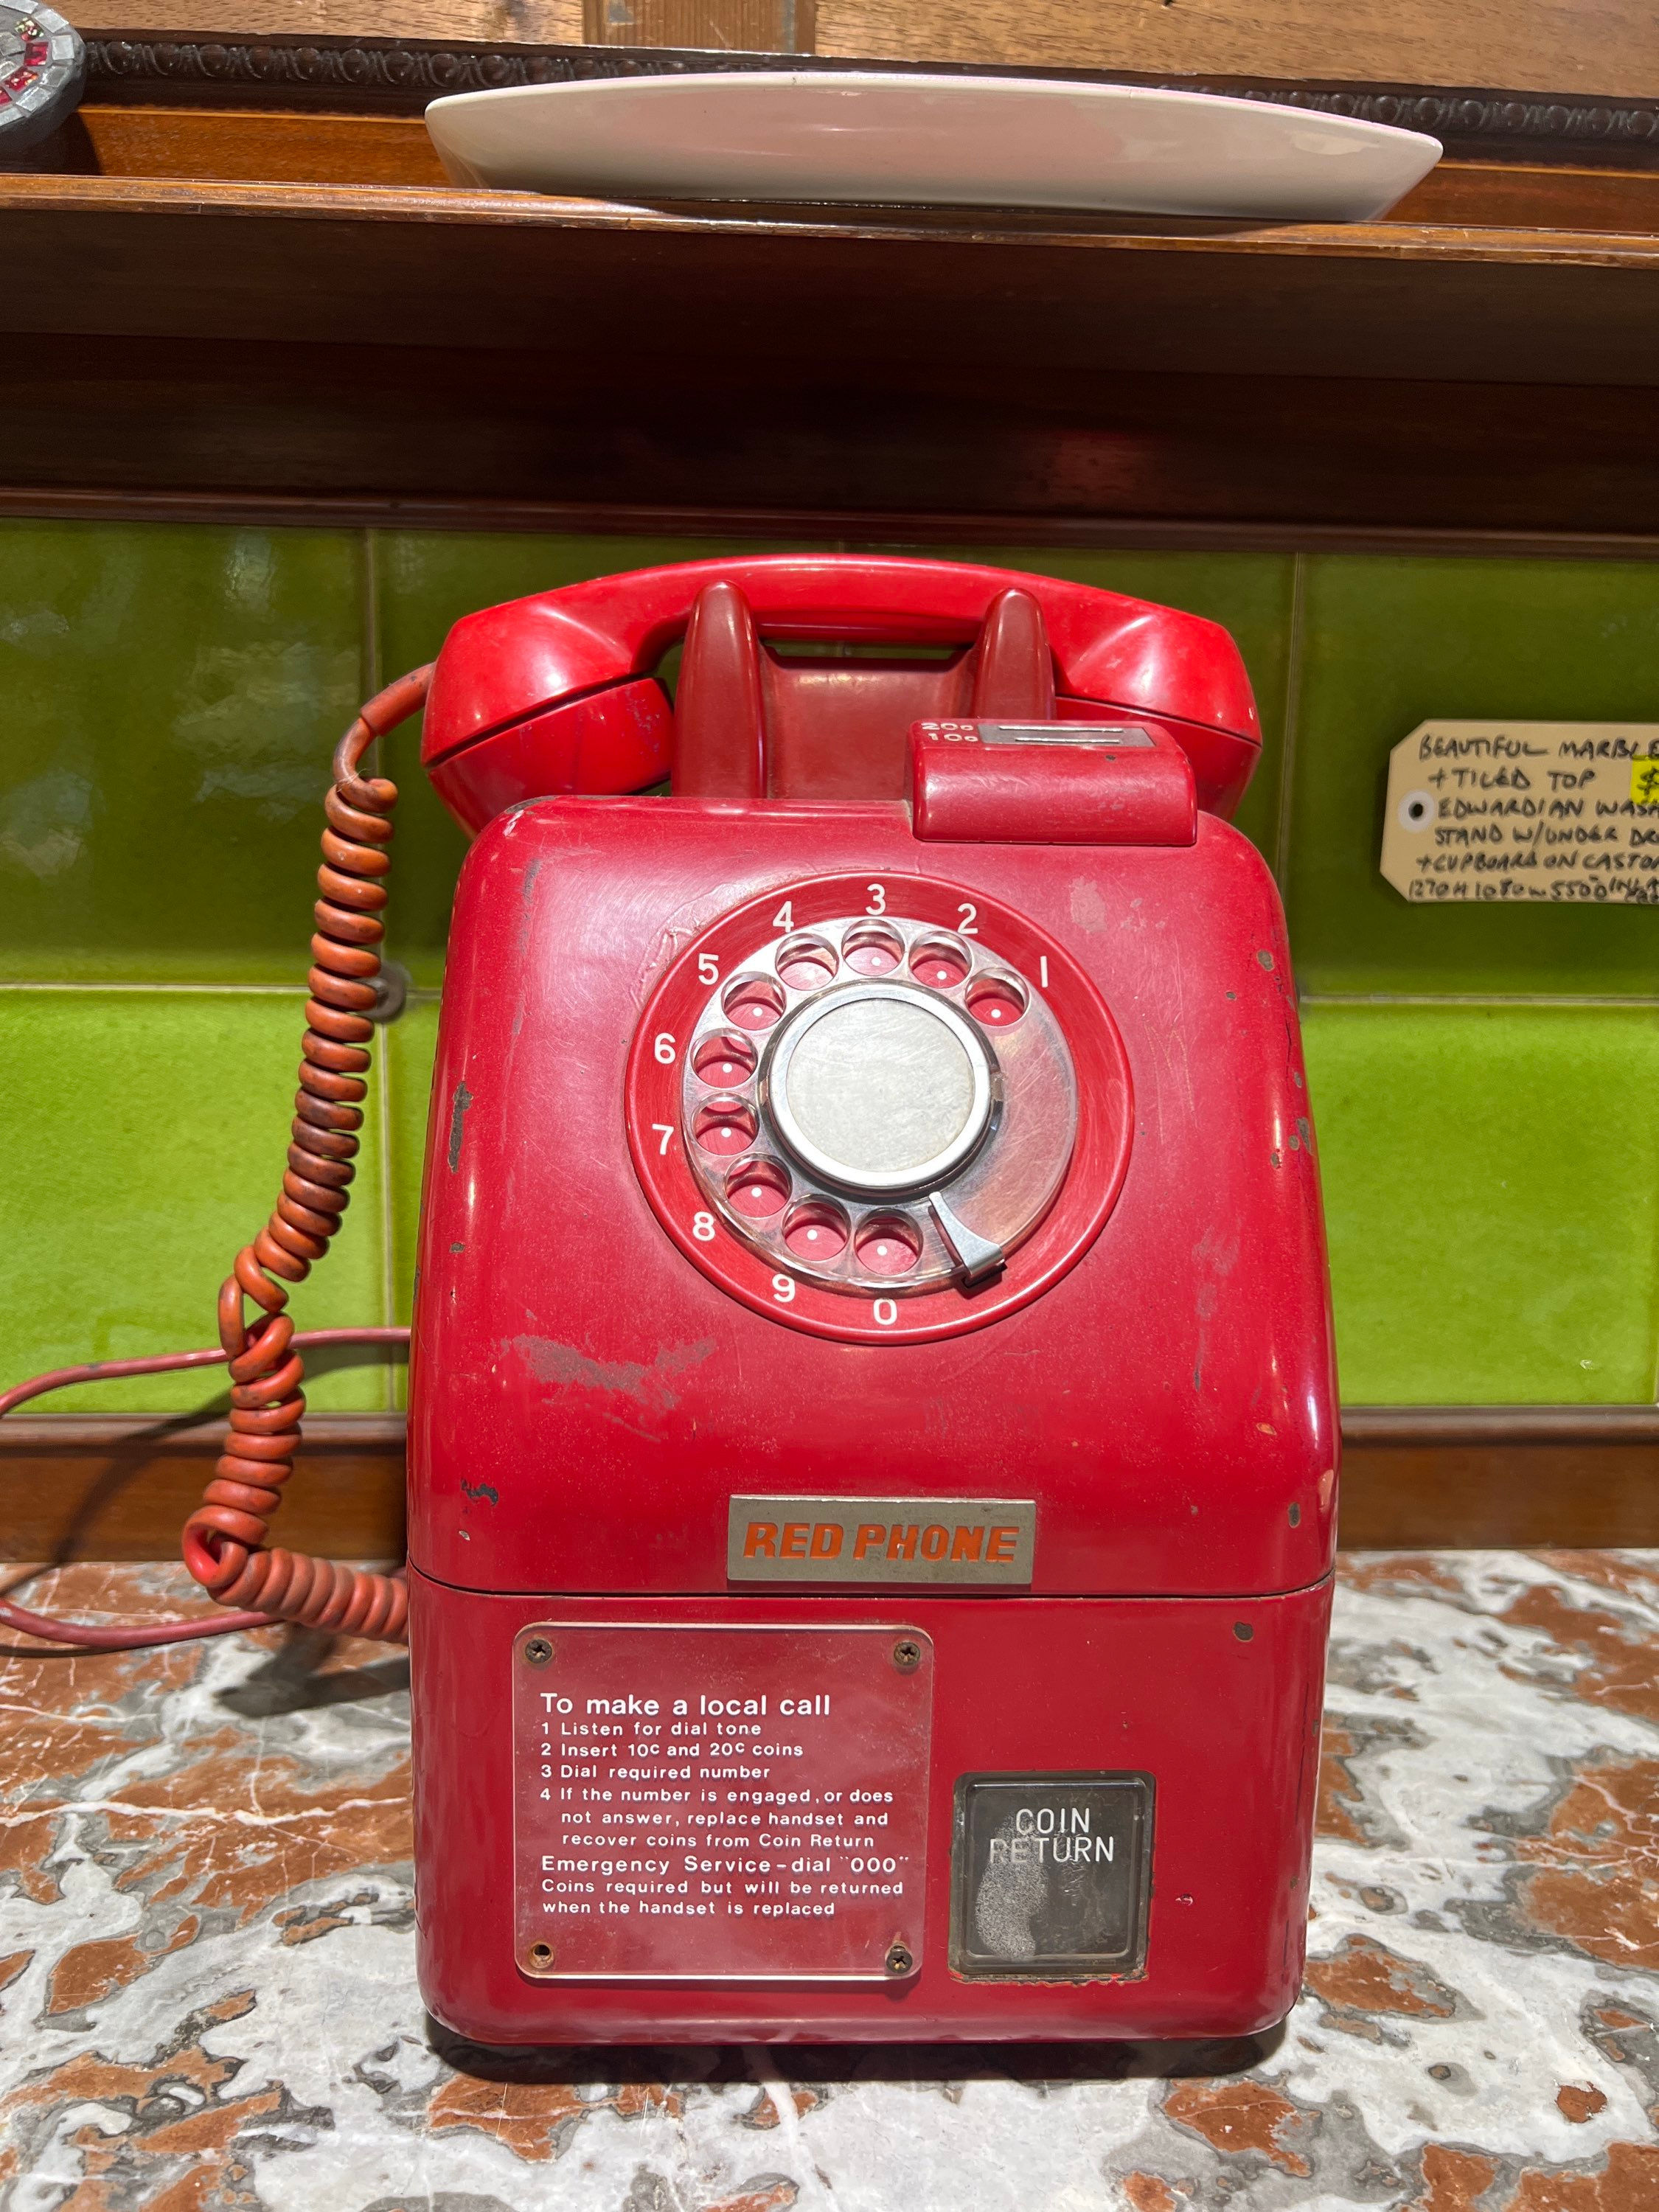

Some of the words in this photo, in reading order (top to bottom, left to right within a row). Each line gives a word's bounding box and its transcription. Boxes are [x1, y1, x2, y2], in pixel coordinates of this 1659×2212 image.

[1419, 734, 1548, 761] BEAUTIFUL
[1547, 768, 1595, 792] TOP
[1438, 796, 1583, 820] EDWARDIAN
[1434, 823, 1503, 846] STAND
[1543, 849, 1578, 869] ON
[866, 883, 886, 916] 3
[772, 900, 797, 934] 4
[953, 902, 978, 938] 2
[698, 953, 722, 987] 5
[1040, 956, 1048, 988] 1
[654, 1032, 676, 1064] 6
[652, 1123, 674, 1155] 7
[692, 1211, 716, 1242] 8
[772, 1273, 796, 1303] 9
[873, 1298, 897, 1326] 0
[742, 1522, 844, 1559] RED
[852, 1523, 1020, 1562] PHONE
[540, 1692, 573, 1714] To
[586, 1694, 660, 1716] make
[672, 1700, 687, 1715] a
[700, 1694, 767, 1716] local
[779, 1694, 830, 1715] call
[541, 1722, 549, 1735] 1
[561, 1722, 623, 1736] Listen
[633, 1722, 662, 1736] for
[671, 1721, 707, 1735] dial
[717, 1722, 762, 1735] tone
[540, 1742, 552, 1756] 2
[561, 1743, 617, 1757] Insert
[667, 1743, 700, 1756] and
[752, 1742, 804, 1756] coins
[541, 1764, 552, 1778] 3
[560, 1764, 597, 1778] Dial
[609, 1765, 691, 1781] required
[700, 1765, 770, 1778] number
[540, 1787, 551, 1801] 4
[560, 1787, 572, 1800] If
[582, 1787, 613, 1801] the
[621, 1788, 691, 1802] number
[701, 1789, 717, 1801] is
[849, 1789, 893, 1803] does
[561, 1811, 591, 1823] not
[602, 1813, 679, 1827] answer,
[687, 1811, 761, 1827] replace
[768, 1812, 844, 1826] handset
[854, 1812, 888, 1826] and
[1015, 1808, 1090, 1835] COIN
[563, 1834, 637, 1846] recover
[646, 1833, 697, 1847] coins
[706, 1834, 749, 1848] from
[759, 1833, 801, 1847] Coin
[810, 1834, 874, 1847] Return
[989, 1836, 1114, 1863] RETURN
[542, 1855, 669, 1876] Emergency
[542, 1879, 595, 1893] Coins
[606, 1880, 688, 1896] required
[701, 1880, 731, 1894] but
[745, 1880, 779, 1894] will
[790, 1881, 812, 1894] be
[821, 1881, 903, 1894] returned
[543, 1901, 591, 1913] when
[599, 1900, 630, 1914] the
[639, 1900, 715, 1915] handset
[728, 1901, 743, 1915] is
[754, 1902, 835, 1917] replaced
